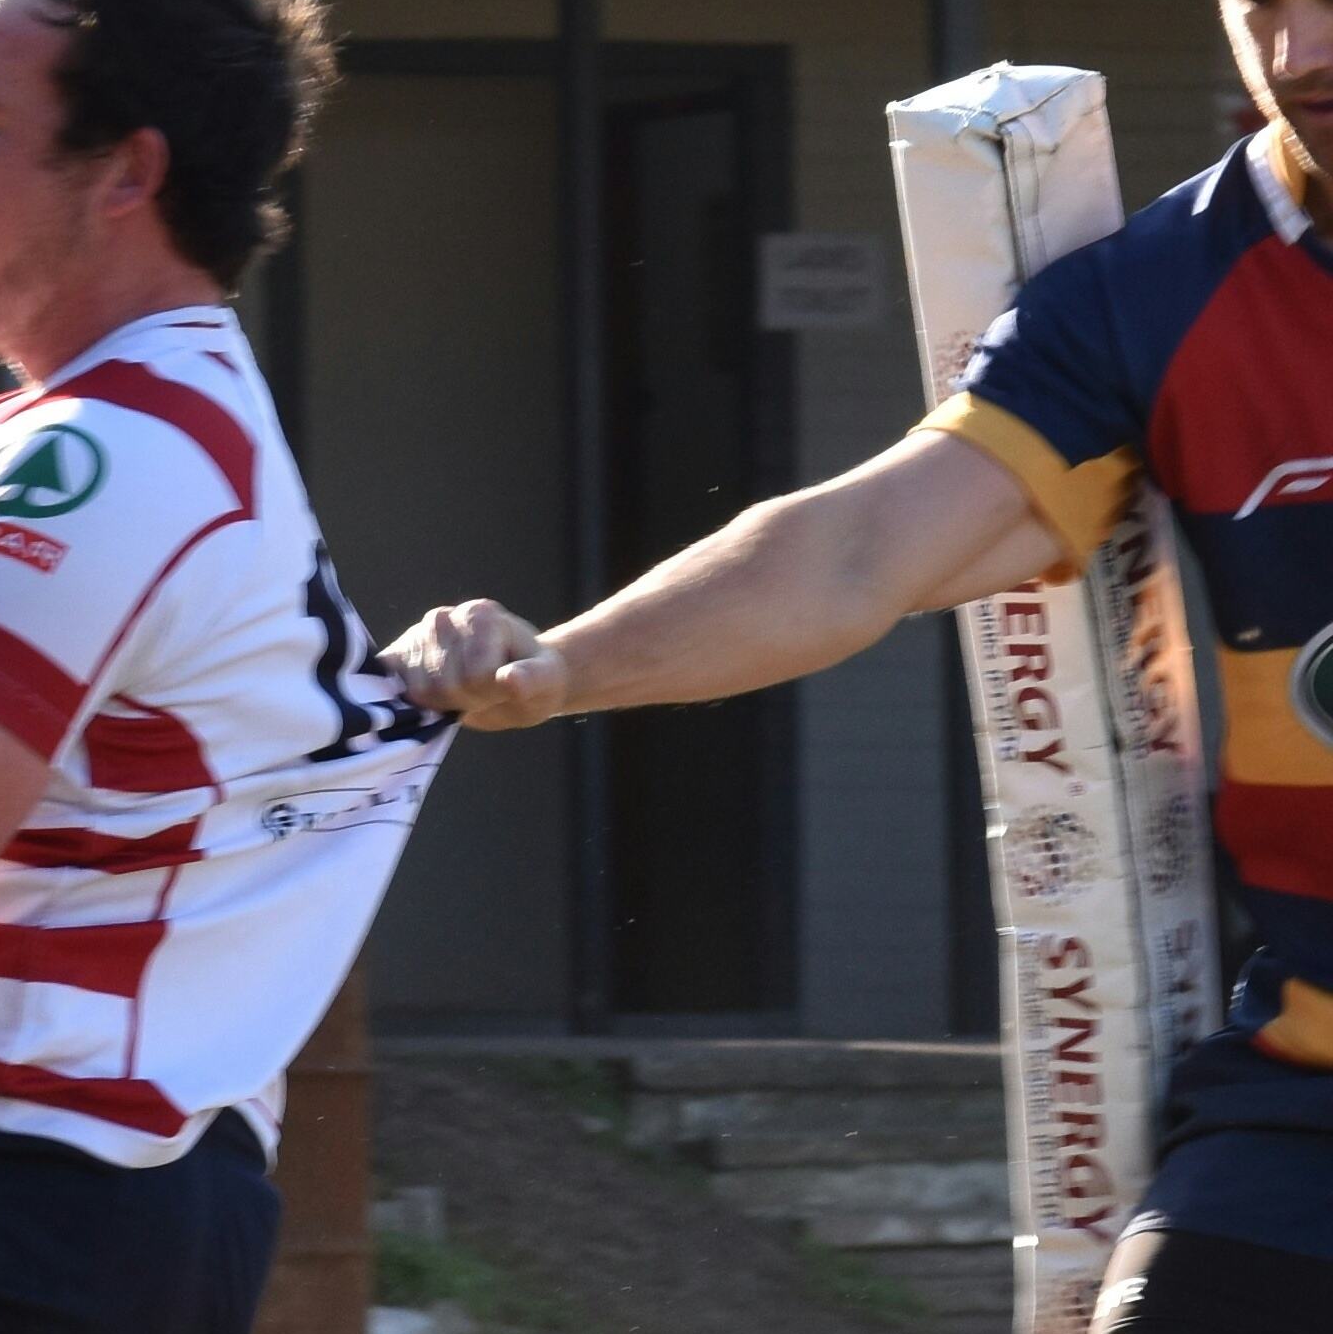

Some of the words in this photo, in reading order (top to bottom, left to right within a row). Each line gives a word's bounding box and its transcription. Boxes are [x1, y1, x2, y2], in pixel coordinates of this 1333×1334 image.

[1000, 581, 1070, 775] ERGY
[1117, 499, 1183, 755] NERGY
[1038, 937, 1118, 1239] SYNERGY
